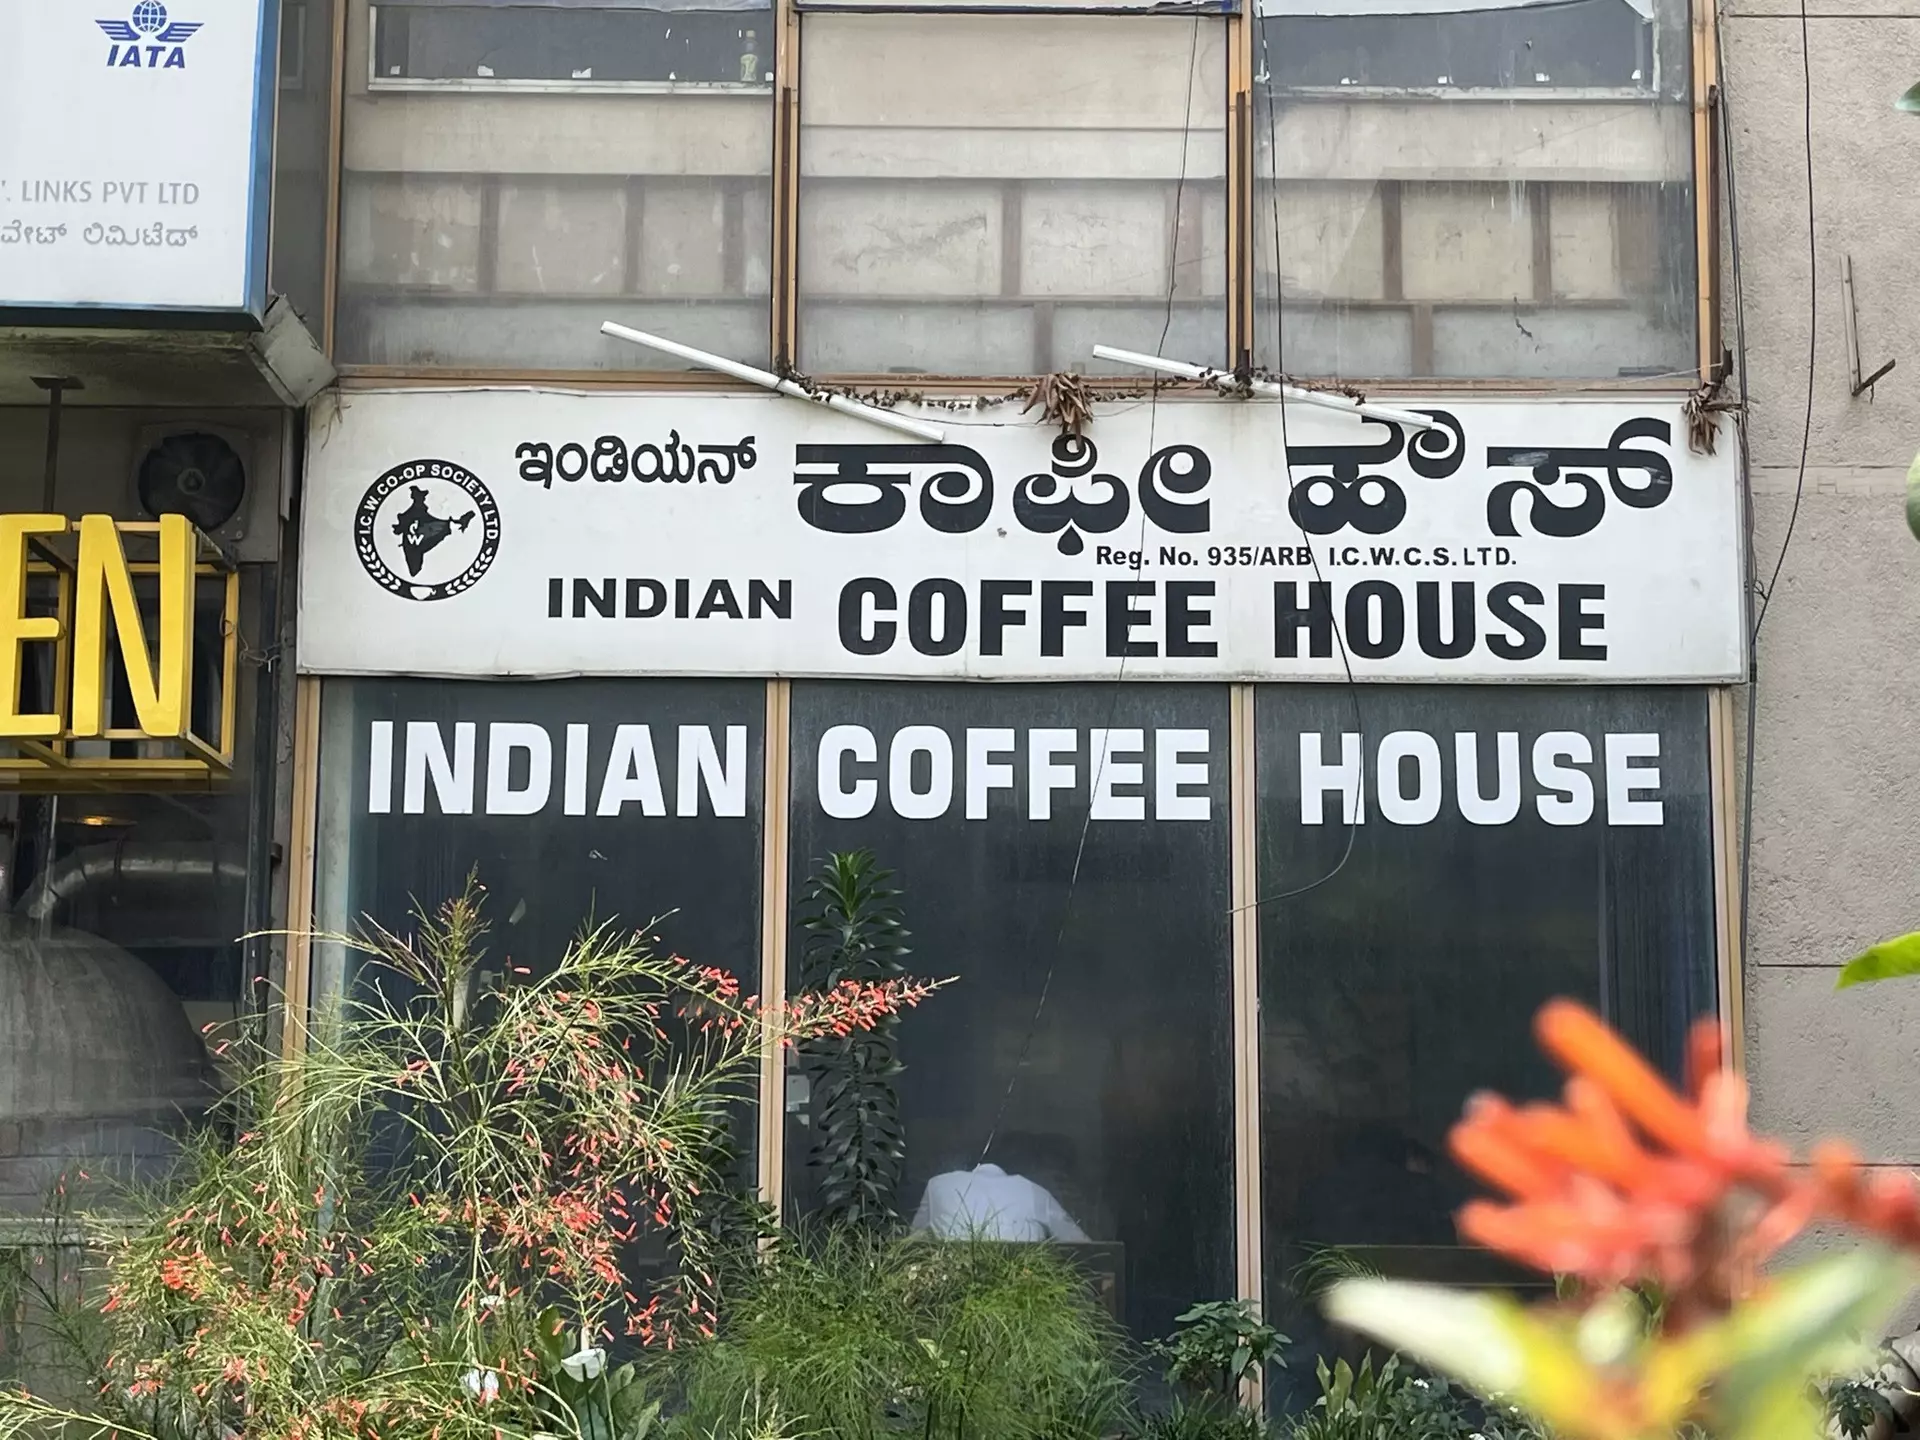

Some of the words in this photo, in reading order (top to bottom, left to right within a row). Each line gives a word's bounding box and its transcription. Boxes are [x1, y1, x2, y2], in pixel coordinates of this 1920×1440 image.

[107, 45, 186, 68] IATA
[22, 180, 92, 202] LINKS
[103, 181, 149, 203] PVT
[159, 183, 200, 204] LTD
[83, 222, 199, 247] ಲಿಮಿಟೆಡ್
[515, 429, 756, 489] ಇಂಡಿಯನ್
[431, 464, 492, 506] SOCIETY
[1096, 545, 1150, 570] Reg.
[1159, 546, 1199, 566] No.
[1207, 546, 1311, 567] 935/ARB
[547, 577, 793, 620] INDIAN
[838, 577, 1218, 658] COFFEE
[1274, 580, 1608, 661] HOUSE
[368, 720, 748, 818] INDIAN
[817, 725, 1212, 821] COFFEE
[1299, 730, 1665, 826] HOUSE
